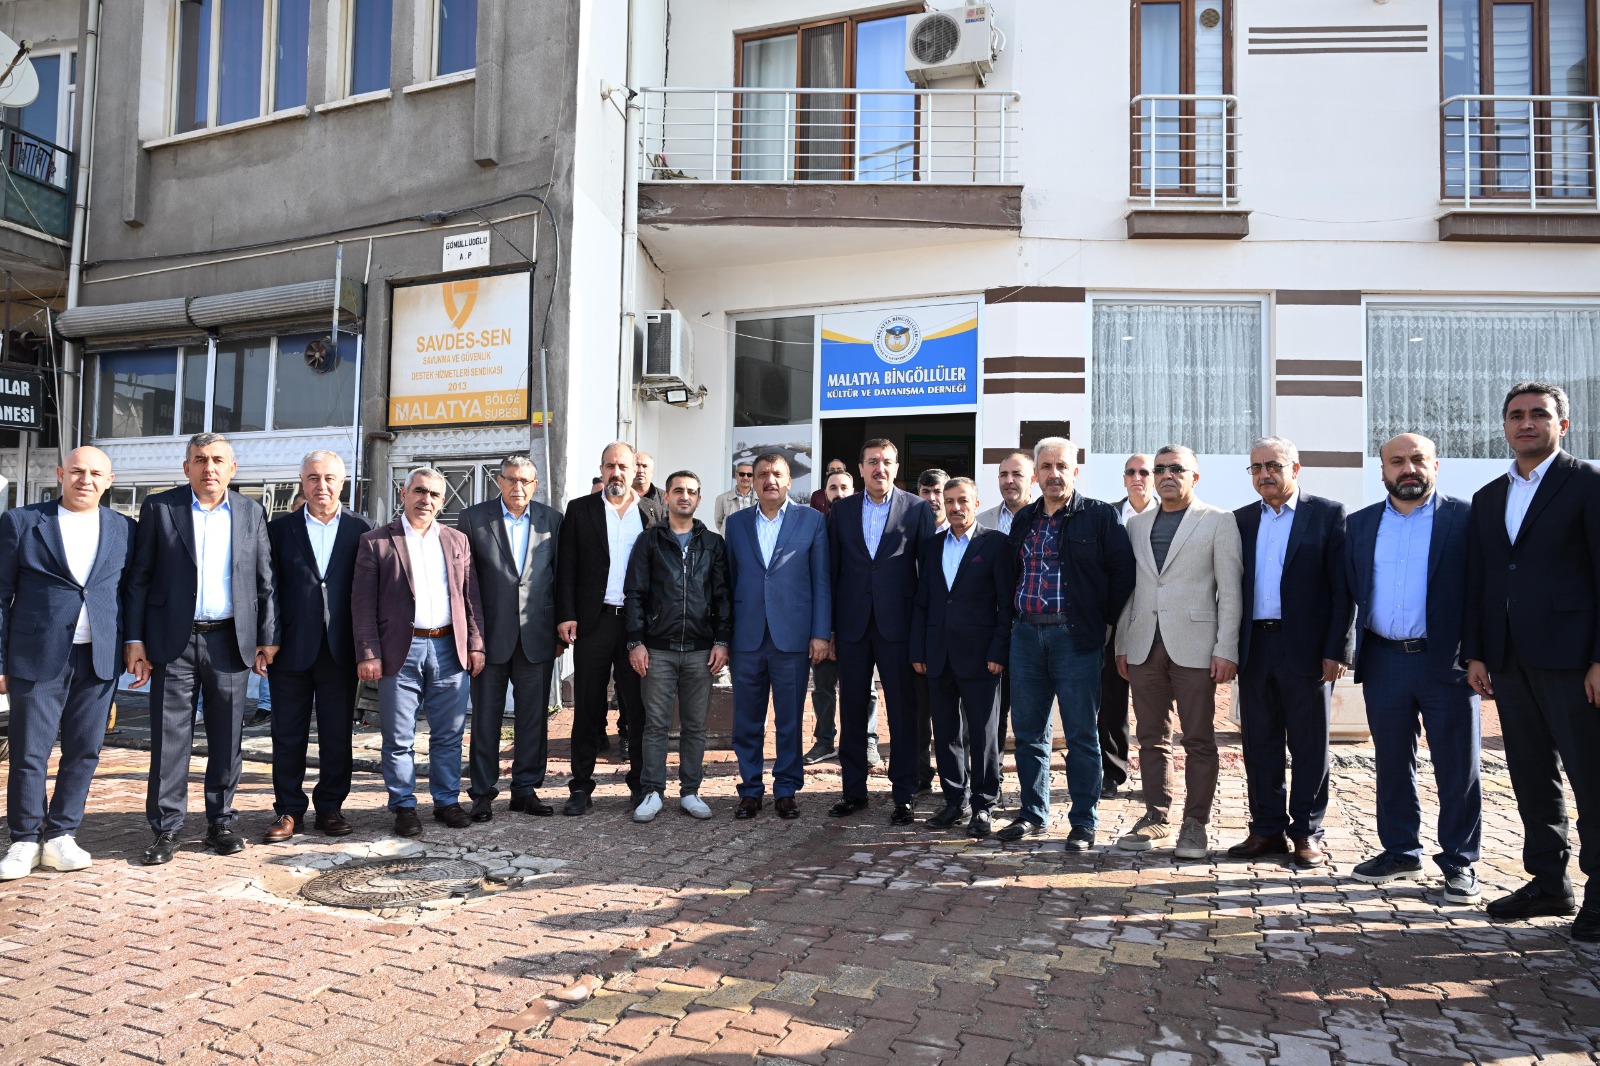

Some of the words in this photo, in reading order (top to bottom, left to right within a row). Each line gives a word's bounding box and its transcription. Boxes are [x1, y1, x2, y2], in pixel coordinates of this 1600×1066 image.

[416, 327, 511, 353] SAVDES-SEN
[422, 355, 451, 365] SAVUNMA
[451, 353, 460, 363] VE
[411, 371, 434, 381] DESTEK
[827, 371, 880, 388] MALATYA
[884, 364, 967, 385] BİNGÖLLÜLER
[447, 381, 468, 392] 2013
[826, 388, 859, 399] KÜLTÜR
[861, 388, 872, 397] VE
[874, 386, 925, 397] DAYANIŞMA
[927, 382, 967, 394] DERNEĞİ
[484, 393, 520, 406] BÖLGE
[394, 398, 483, 422] MALATYA
